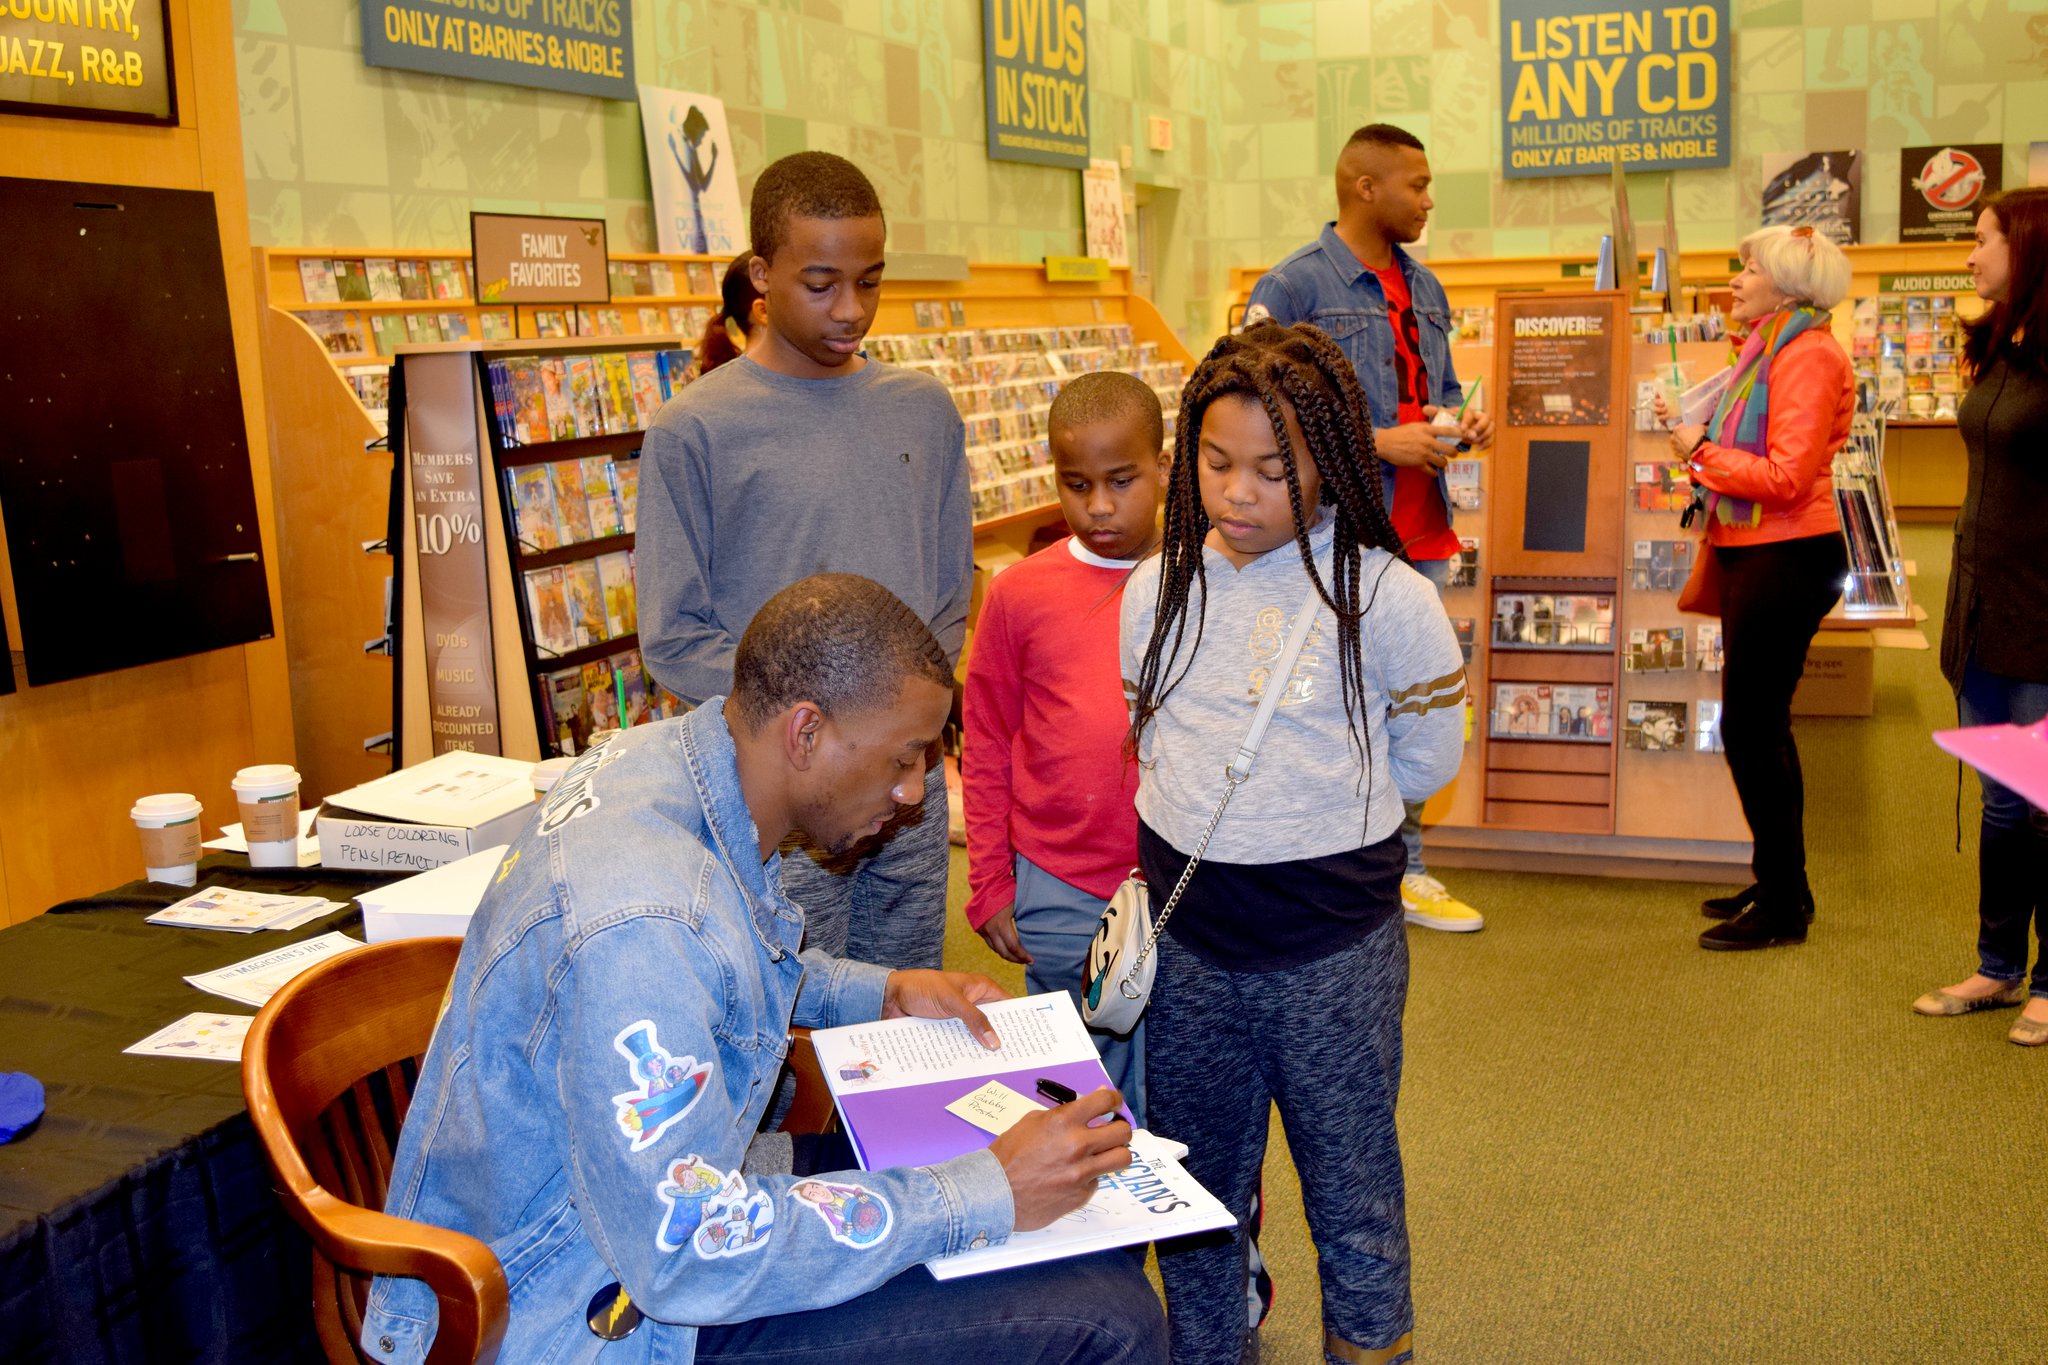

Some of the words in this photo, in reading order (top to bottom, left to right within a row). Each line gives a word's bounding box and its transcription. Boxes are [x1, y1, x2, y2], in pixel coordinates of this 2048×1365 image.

[0, 0, 140, 41] OUNTRY,
[541, 0, 622, 37] TRACKS
[384, 6, 440, 48] ONLY
[443, 17, 466, 53] AT
[468, 21, 546, 66] BARNES
[546, 35, 565, 69] &
[565, 39, 624, 78] NOBLE
[1511, 10, 1652, 62] LISTEN
[1663, 5, 1718, 50] TO
[0, 36, 75, 86] JAZZ,
[81, 45, 144, 87] R&B
[1507, 57, 1628, 122] ANY
[1637, 51, 1718, 114] CD
[996, 65, 1019, 127] IN
[1021, 71, 1087, 138] STOCK
[1511, 121, 1604, 147] MILLIONS
[1607, 119, 1634, 141] OF
[1637, 115, 1718, 139] TRACKS
[1511, 146, 1554, 169] ONLY
[1554, 147, 1574, 166] AT
[1643, 141, 1658, 161] &
[1660, 138, 1718, 160] NOBLE
[521, 233, 567, 258] FAMILY
[510, 262, 581, 287] FAVORITES
[1892, 277, 1931, 291] AUDIO
[1933, 275, 1976, 290] BOOKS
[1514, 316, 1586, 337] DISCOVER
[413, 452, 474, 466] MEMBERS
[425, 470, 455, 484] SAVE
[416, 492, 427, 502] AN
[430, 488, 475, 503] EXTRA
[417, 513, 481, 555] 10%
[436, 633, 468, 648] DVDs
[437, 668, 474, 683] MUSIC
[437, 705, 482, 718] ALREADY
[433, 719, 494, 735] DISCOUNTED
[444, 739, 476, 752] ITEMS
[344, 824, 387, 838] LOOSE
[387, 826, 460, 847] COLORING
[218, 971, 237, 980] THE
[236, 949, 305, 975] MAGICIAN'S
[305, 941, 330, 953] HAT
[974, 1094, 1007, 1113] Gabby
[986, 1086, 1008, 1100] Will
[1147, 1158, 1167, 1170] THE
